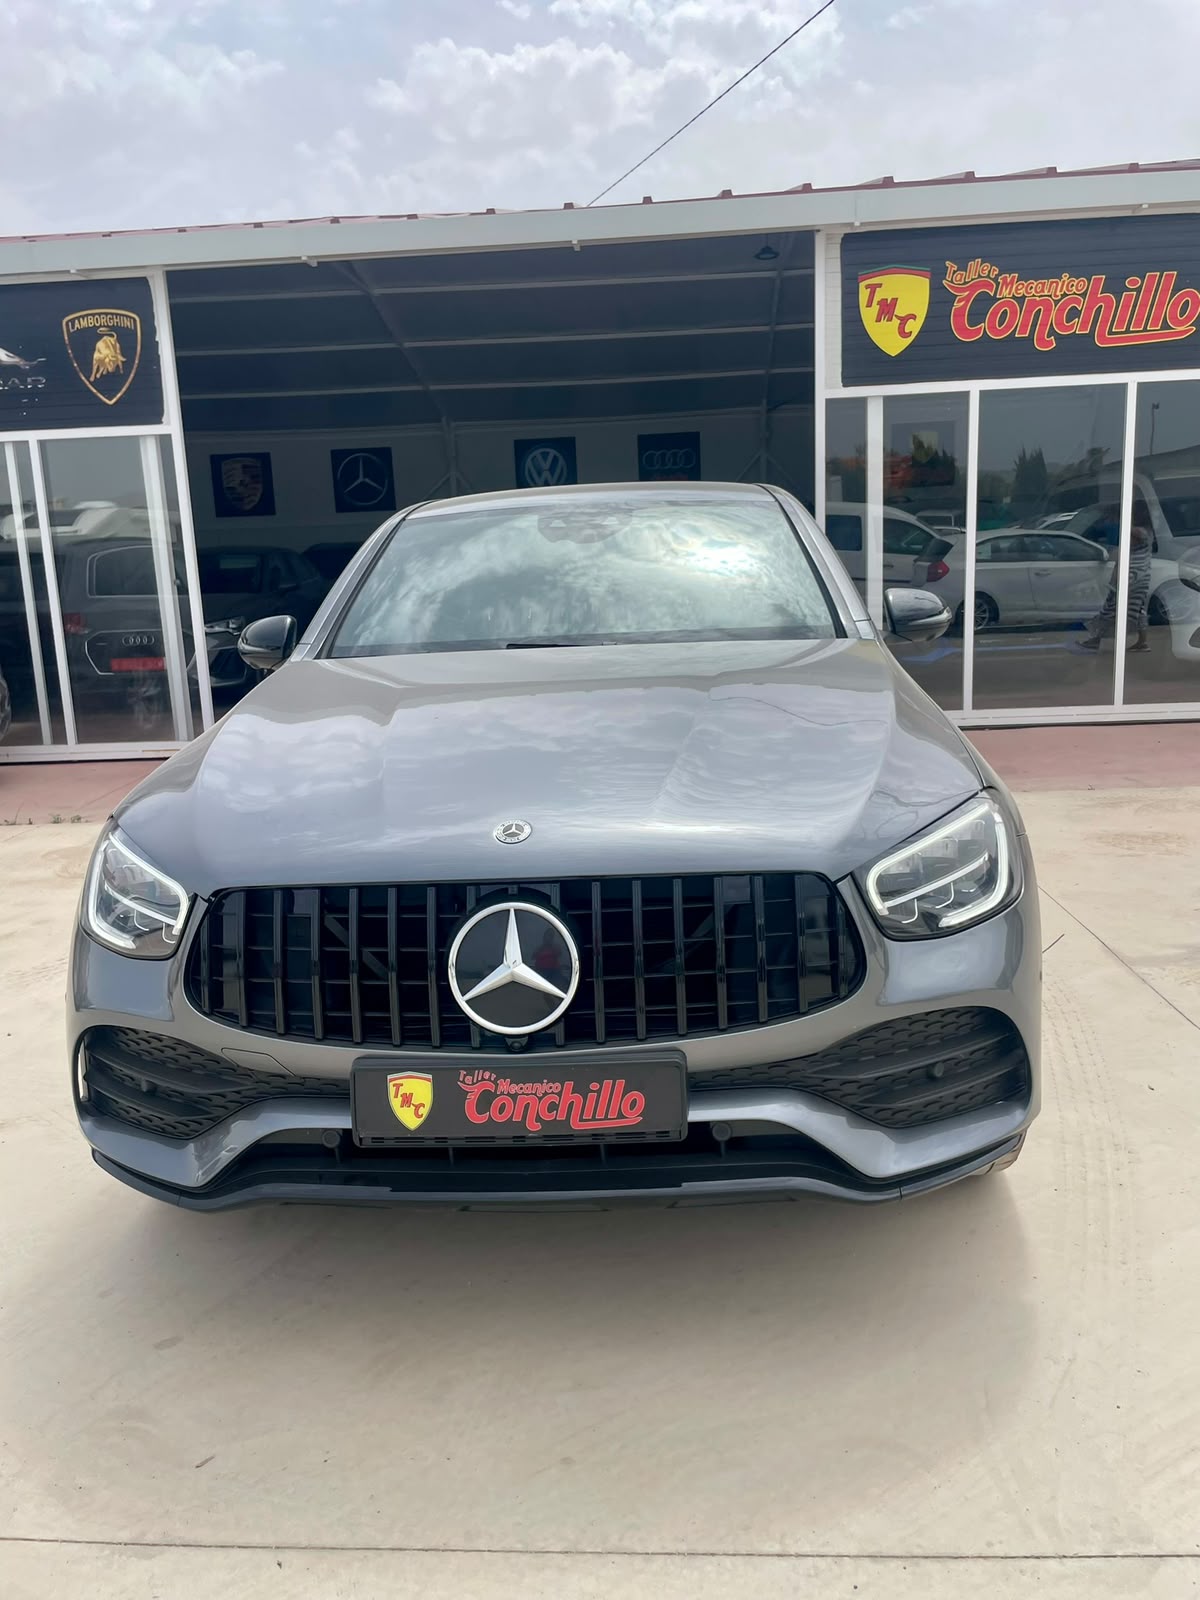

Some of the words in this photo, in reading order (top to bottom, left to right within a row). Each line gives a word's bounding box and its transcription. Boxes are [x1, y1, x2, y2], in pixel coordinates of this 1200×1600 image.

[945, 258, 999, 284] Taller
[996, 272, 1088, 299] Mecanico
[68, 314, 135, 333] LAMBORGHINI
[942, 271, 1200, 351] Conchillo
[459, 1069, 497, 1084] Taller
[496, 1078, 562, 1097] Mecanico
[457, 1079, 645, 1131] Conchillo
